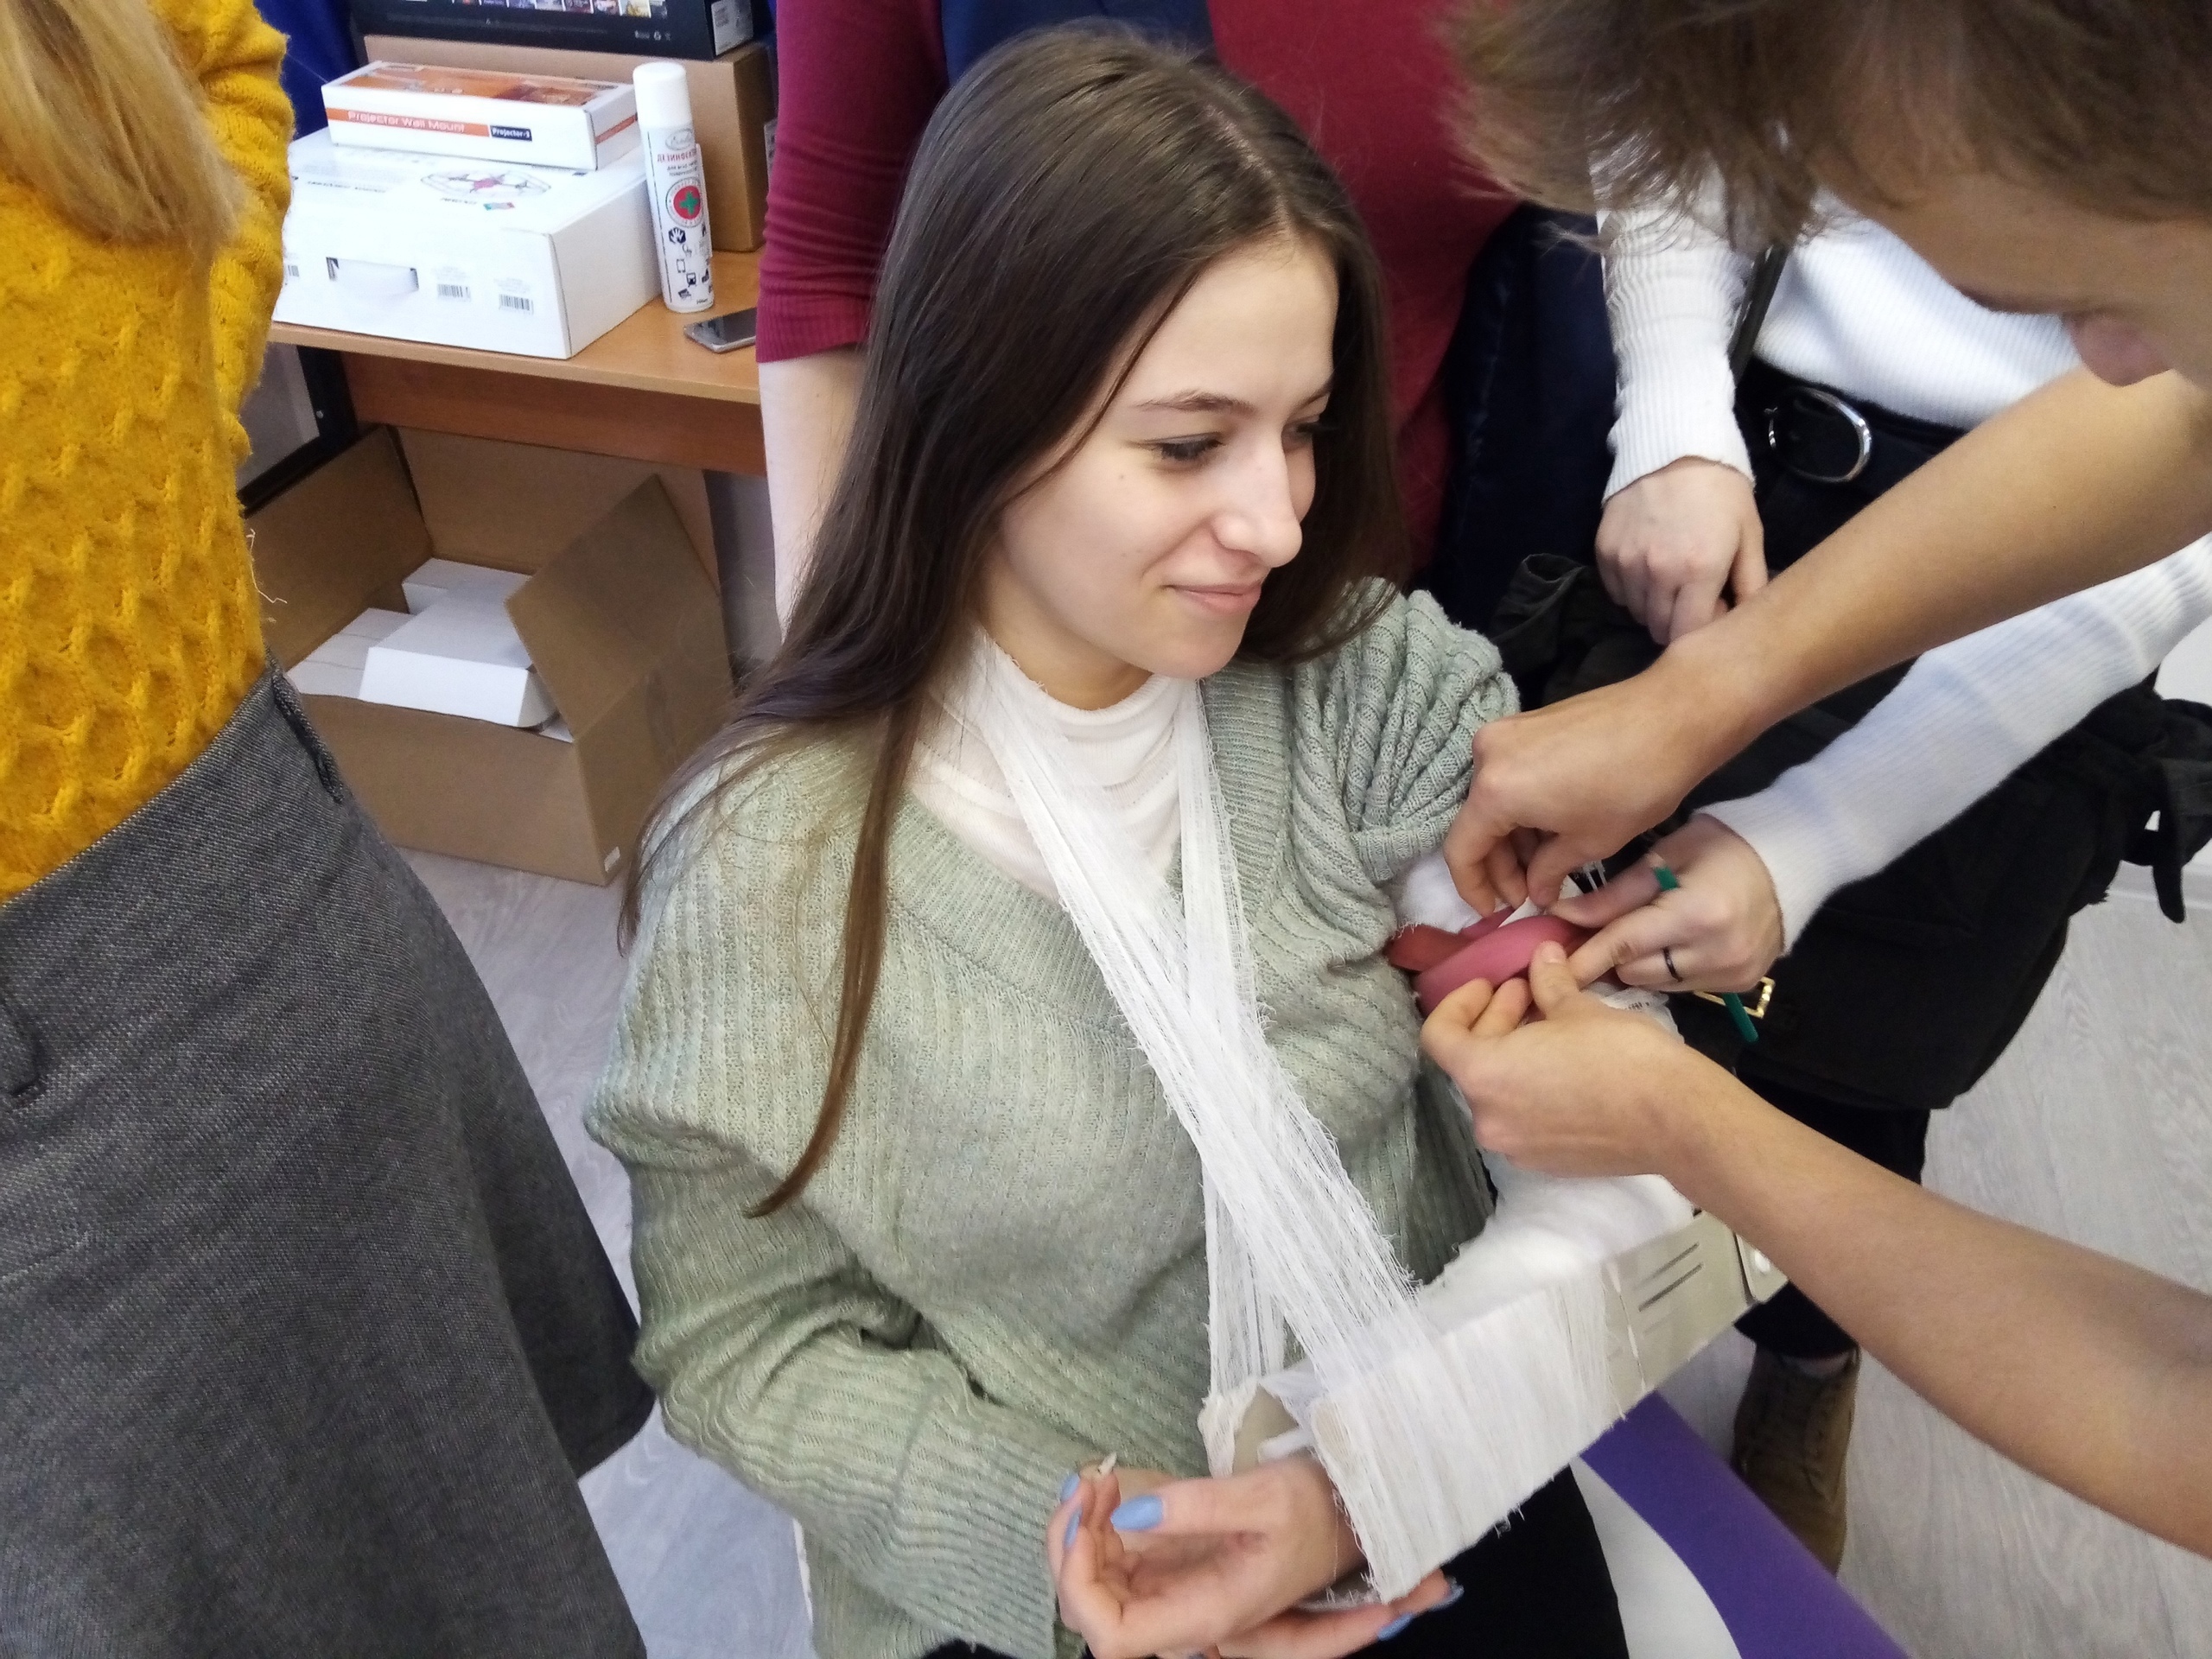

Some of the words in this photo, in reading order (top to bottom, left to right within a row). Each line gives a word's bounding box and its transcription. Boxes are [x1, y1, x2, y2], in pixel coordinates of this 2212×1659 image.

[347, 110, 398, 125] Projector
[403, 118, 426, 129] Wall
[428, 120, 465, 133] Mount
